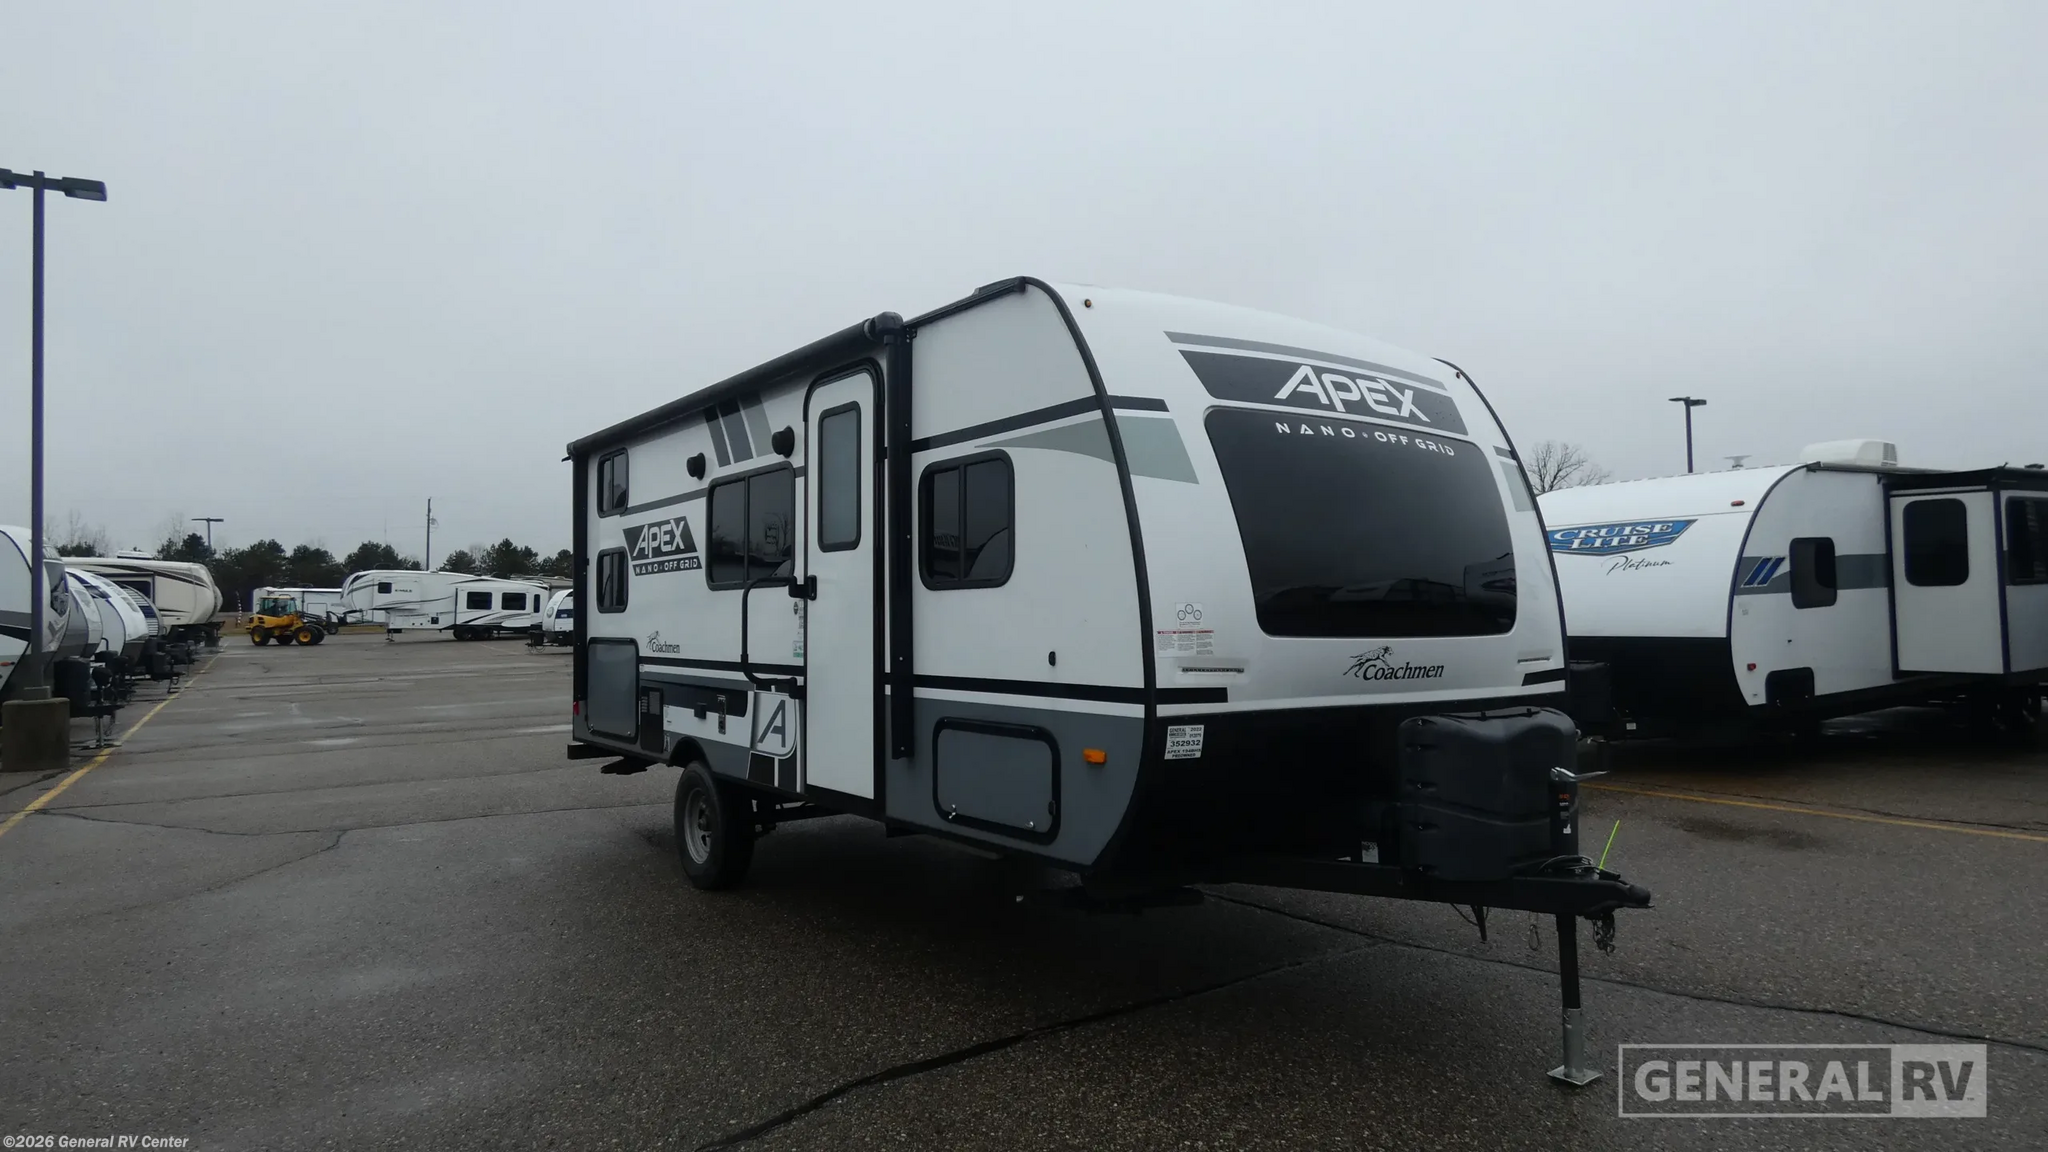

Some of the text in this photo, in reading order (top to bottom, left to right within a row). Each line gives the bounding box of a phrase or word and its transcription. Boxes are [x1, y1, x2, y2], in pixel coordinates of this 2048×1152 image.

[1274, 365, 1431, 422] APEX
[1275, 422, 1455, 457] NANO OFF GRID
[632, 519, 685, 559] APEX
[1553, 523, 1673, 540] CRUISE
[1571, 534, 1649, 549] LITE
[635, 558, 698, 574] NANO OFF GRID
[1601, 555, 1674, 576] Platinum
[651, 641, 681, 654] Coachmen
[1363, 661, 1444, 681] Coachmen
[1170, 739, 1201, 748] 352932
